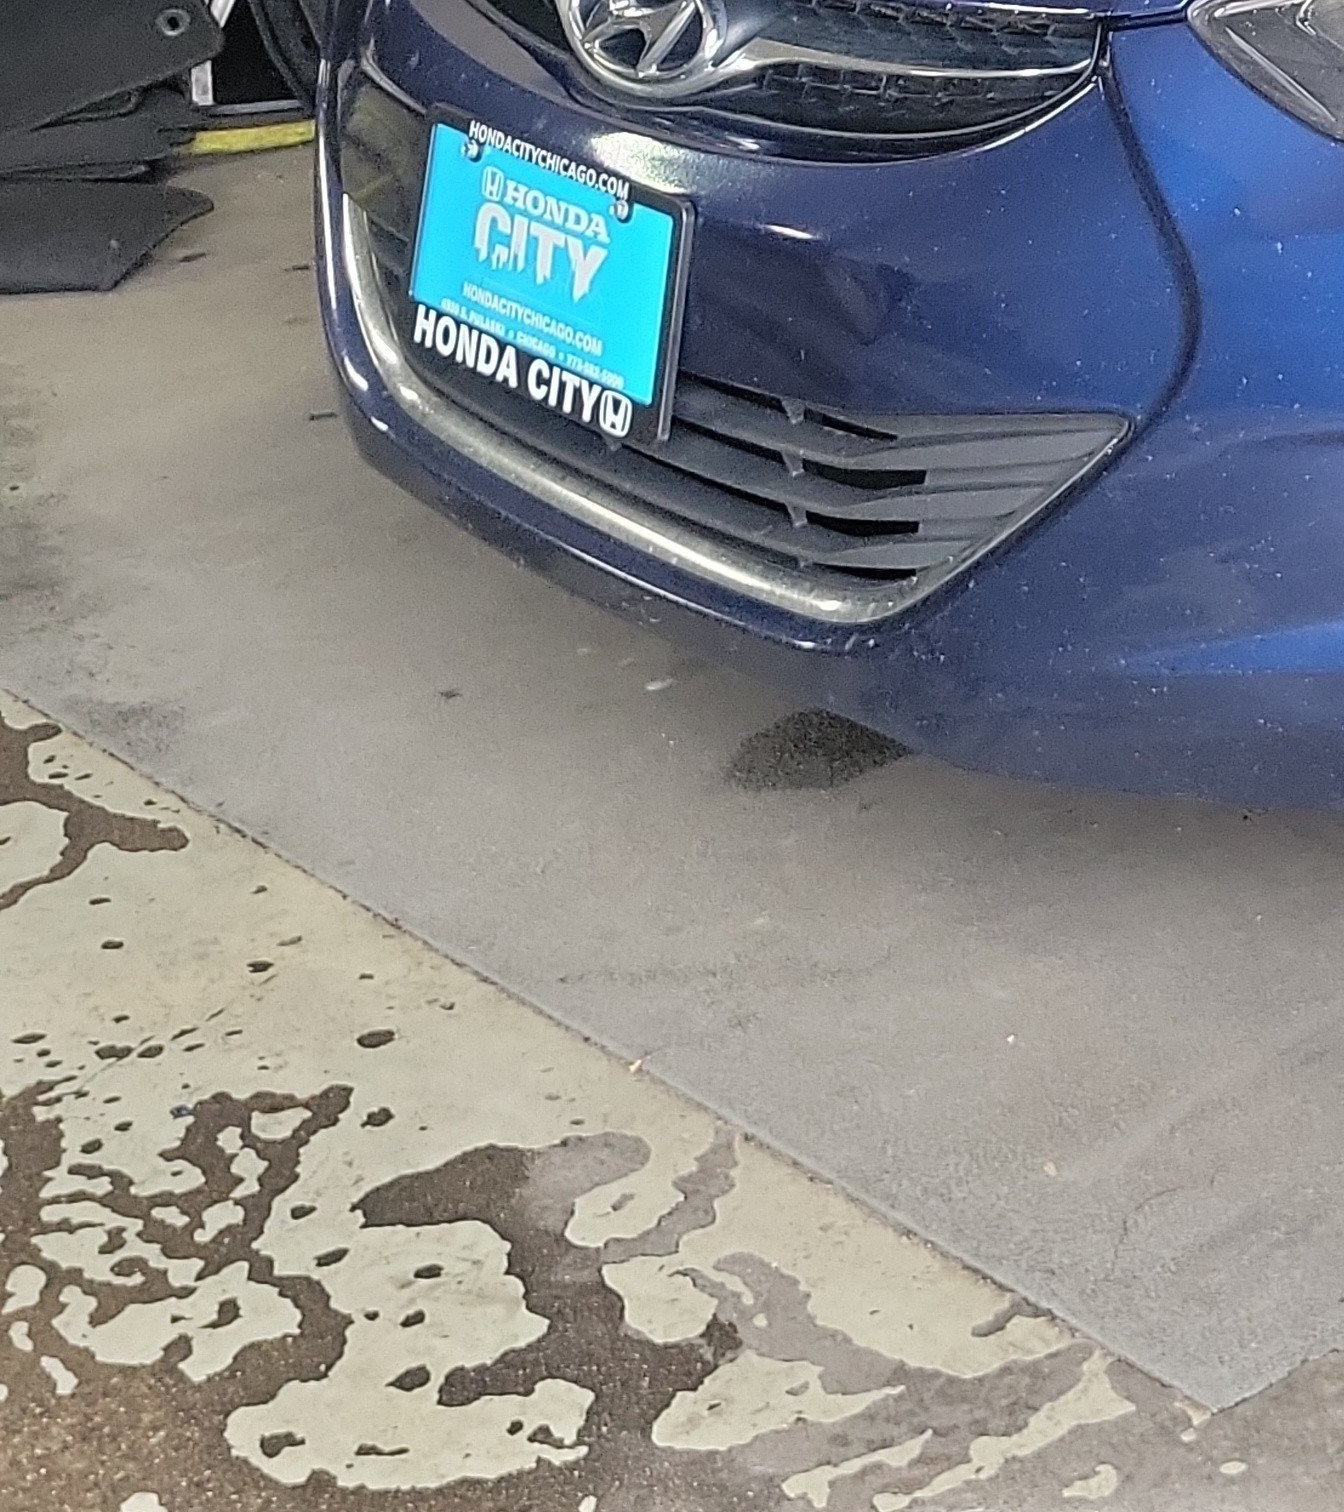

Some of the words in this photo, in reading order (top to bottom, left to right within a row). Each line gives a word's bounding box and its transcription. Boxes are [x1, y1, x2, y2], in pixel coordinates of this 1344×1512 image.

[469, 120, 630, 201] HONDACITYCHICAGO.COM
[503, 178, 611, 244] HONDA
[474, 202, 608, 303] CITY
[463, 282, 603, 356] HONDACITYCHICAGO.COM
[413, 305, 518, 389] HONDA
[527, 359, 602, 424] CITY
